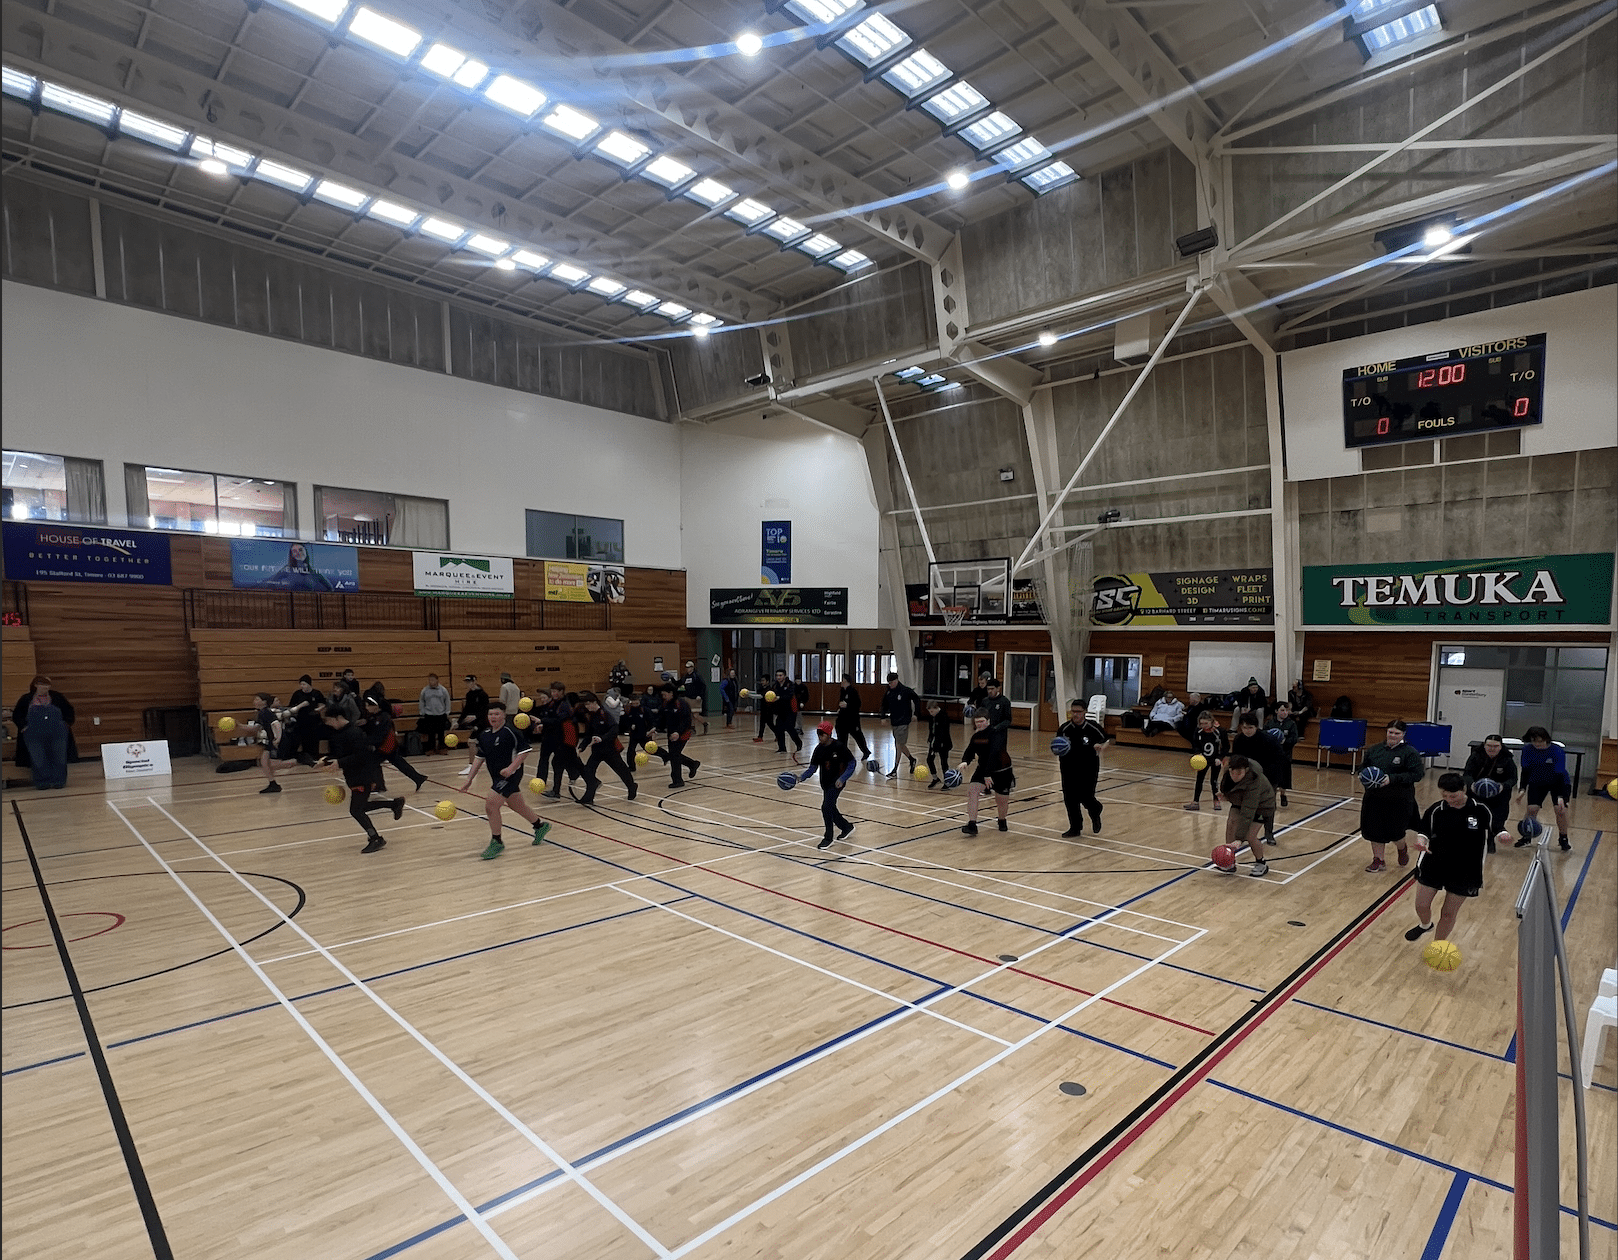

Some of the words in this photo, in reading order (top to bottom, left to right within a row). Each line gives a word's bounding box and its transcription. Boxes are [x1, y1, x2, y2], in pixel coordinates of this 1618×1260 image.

[1459, 337, 1528, 359] VISITORS
[1358, 361, 1397, 377] HOME
[1510, 370, 1535, 382] T/O
[1351, 397, 1371, 407] T/O
[1514, 397, 1529, 416] 0
[1377, 417, 1389, 435] 0
[1418, 417, 1455, 429] FOULS
[766, 528, 783, 536] TOP
[40, 534, 80, 545] HOUSE
[82, 536, 97, 546] OF
[100, 538, 137, 548] TRAVEL
[29, 552, 78, 561] BETTER
[87, 555, 150, 564] TOGETHER
[1176, 575, 1219, 585] SIGNAGE
[1232, 574, 1268, 583] WRAPS
[1181, 586, 1216, 595] DESIGN
[1237, 585, 1263, 593] FLEET
[1332, 570, 1565, 606] TEMUKA
[1186, 597, 1199, 605] 3D
[1242, 596, 1271, 604] PRINT
[1424, 609, 1566, 621] TRANSPORT
[1203, 742, 1215, 756] 9
